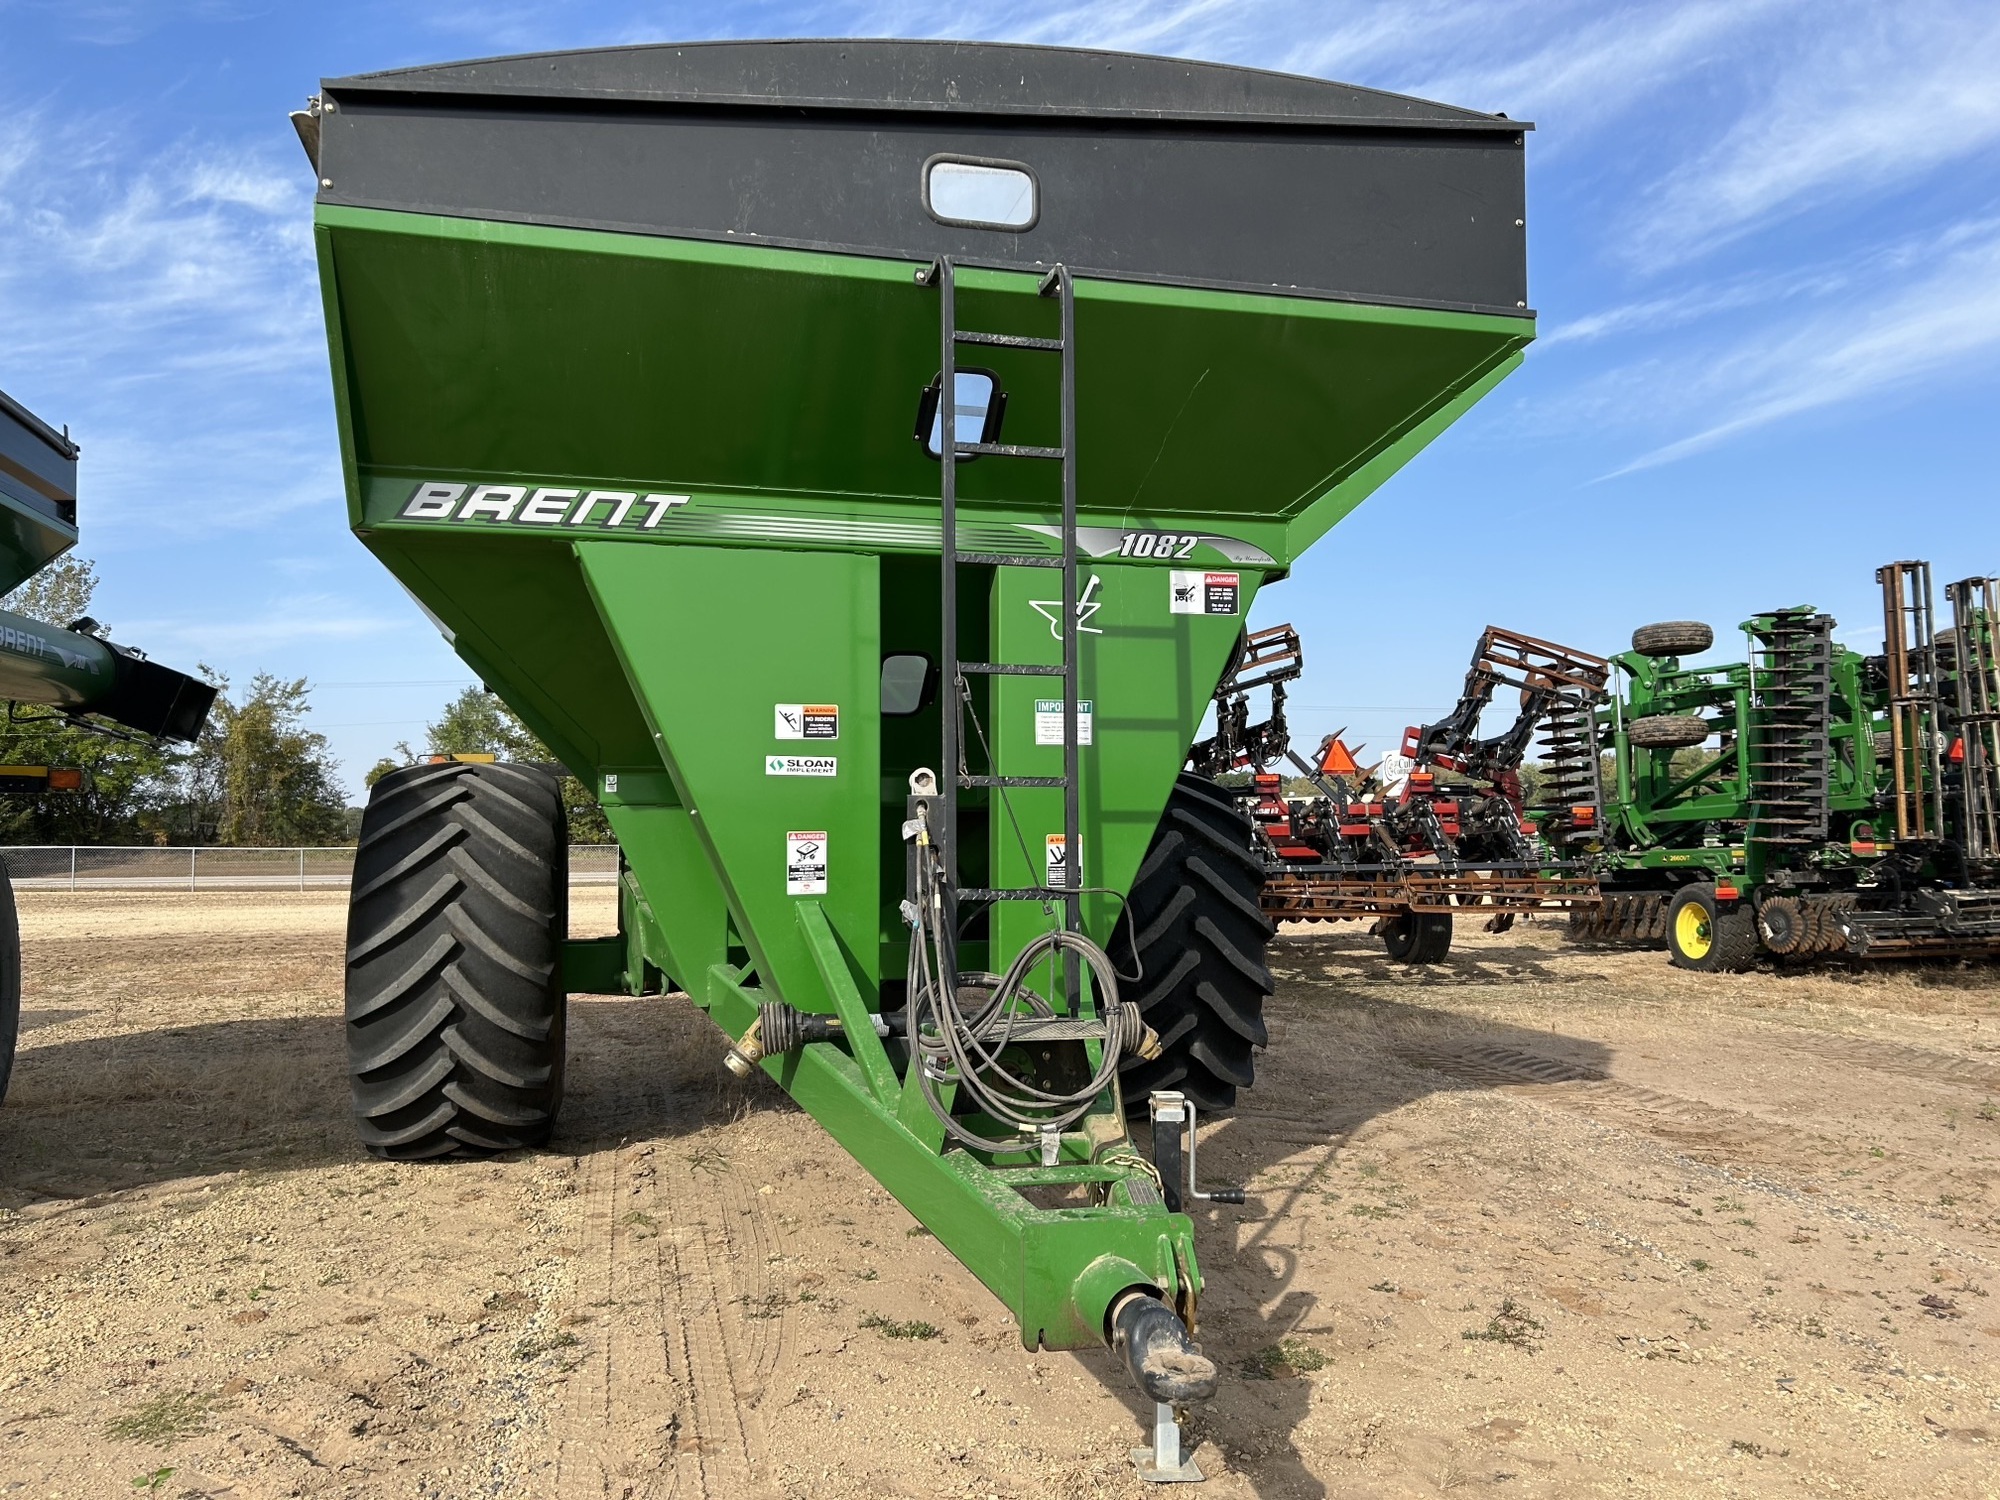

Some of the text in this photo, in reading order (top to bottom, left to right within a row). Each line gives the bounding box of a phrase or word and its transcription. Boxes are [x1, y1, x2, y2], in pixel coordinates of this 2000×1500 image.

[399, 481, 693, 530] BRENT
[1119, 532, 1198, 559] 1082
[1211, 575, 1238, 584] DANGER
[786, 759, 834, 767] SLOAN
